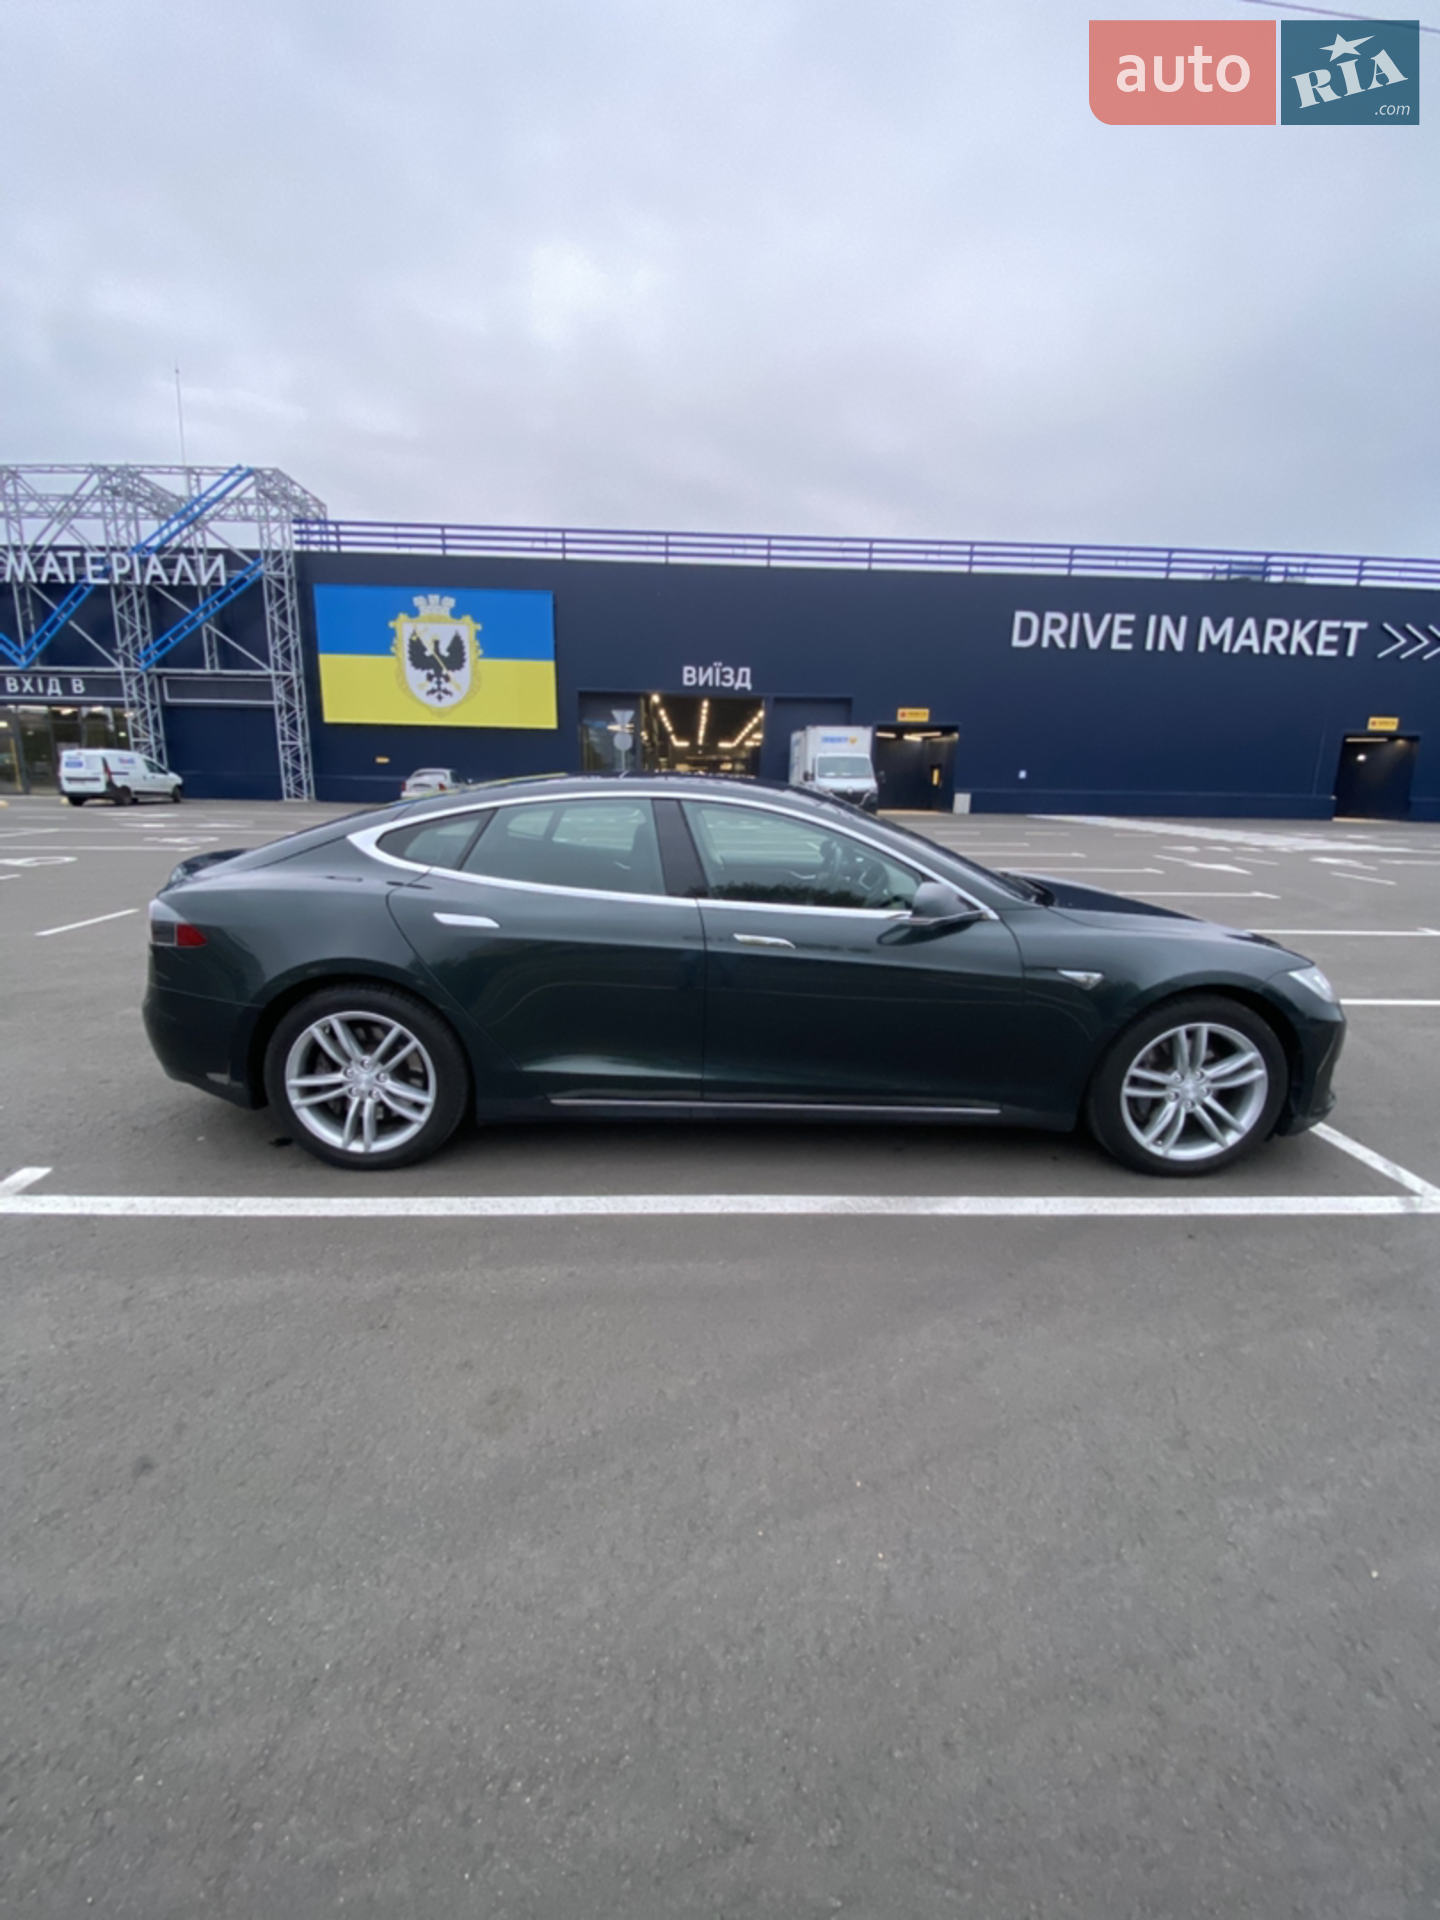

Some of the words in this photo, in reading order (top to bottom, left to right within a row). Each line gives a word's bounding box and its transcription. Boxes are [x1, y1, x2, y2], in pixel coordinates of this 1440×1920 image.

[4, 551, 227, 586] МАТЕРІАЛИ
[1011, 610, 1136, 651] DRIVE
[1144, 614, 1188, 653] IN
[1197, 616, 1368, 658] MARKET
[6, 676, 63, 696] ВХІД
[71, 678, 86, 694] В
[682, 662, 752, 691] ВИЇЗД
